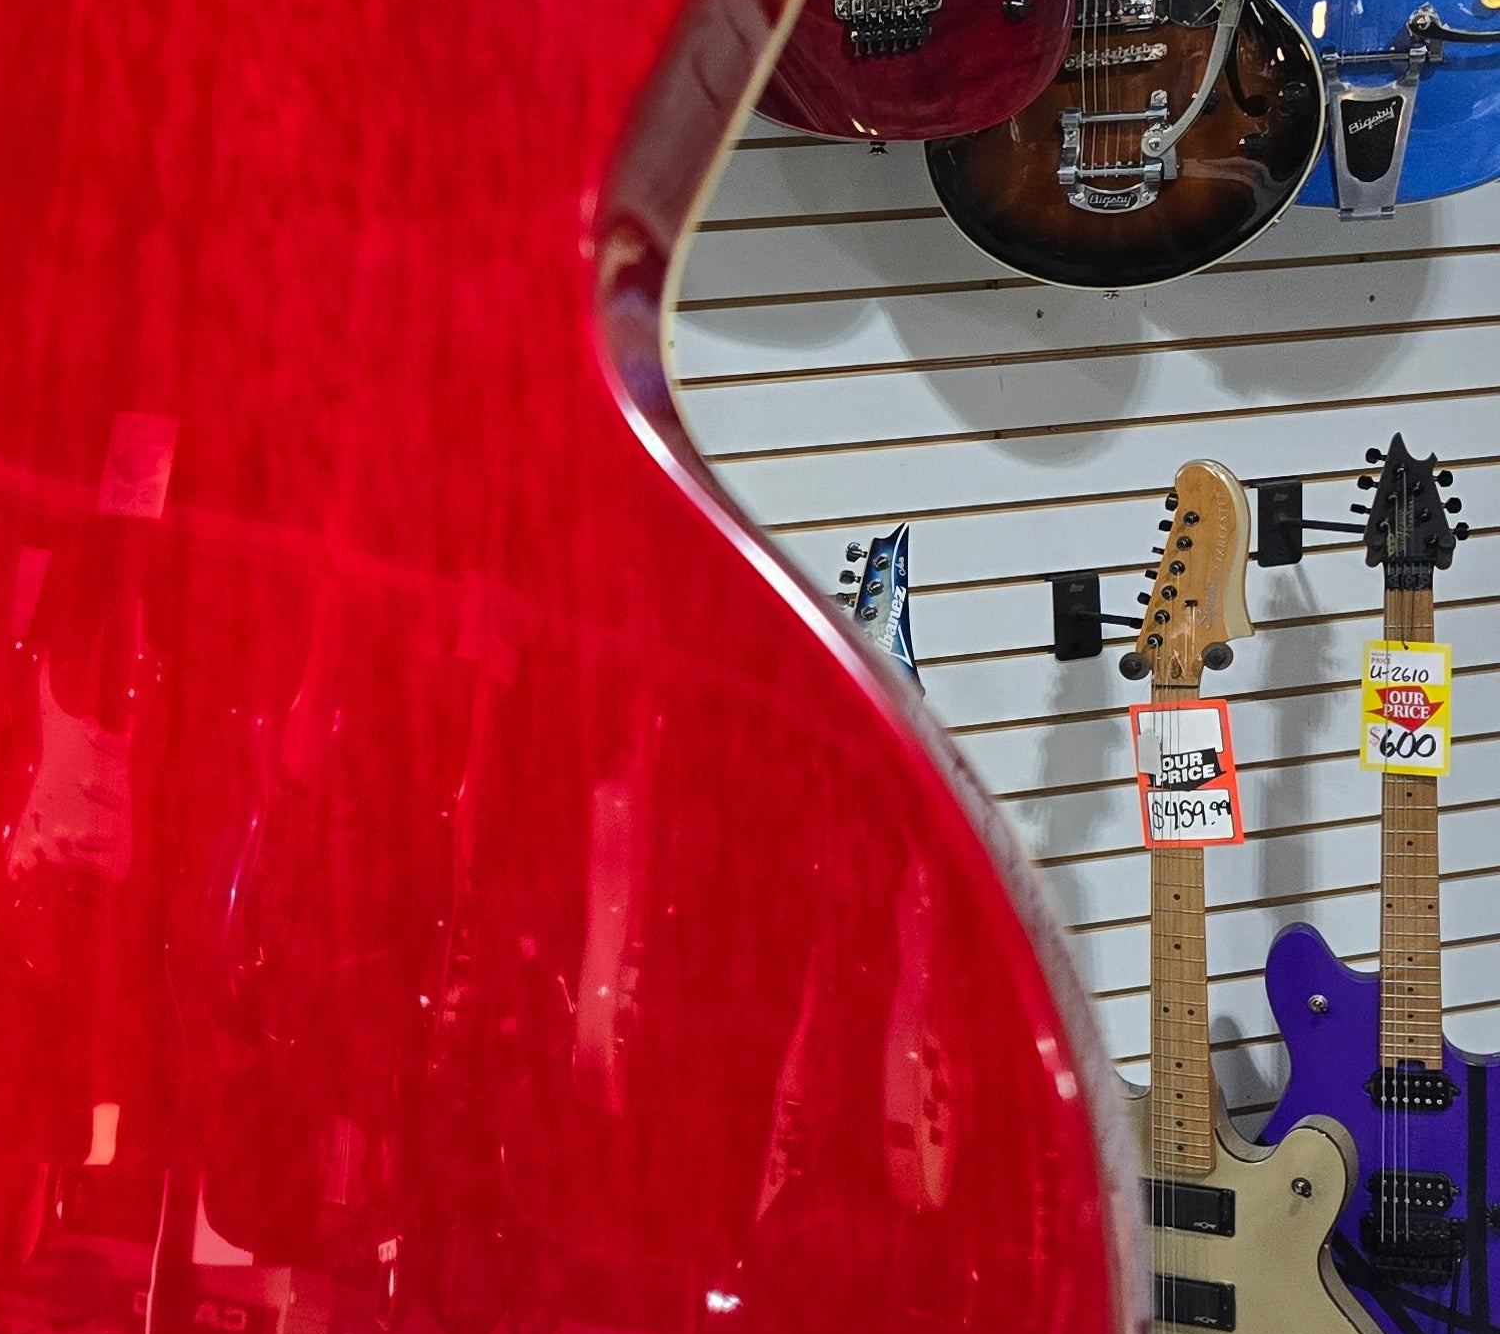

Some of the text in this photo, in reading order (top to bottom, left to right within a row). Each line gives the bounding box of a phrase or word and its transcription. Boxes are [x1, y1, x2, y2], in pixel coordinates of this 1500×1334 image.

[1347, 104, 1396, 135] Bigsby
[1089, 193, 1132, 208] Bigsby
[876, 585, 907, 657] Ibanez
[1389, 690, 1425, 706] OUR
[1383, 703, 1431, 719] PRICE
[1369, 727, 1437, 760] $600
[1162, 752, 1204, 772] OUR
[1155, 763, 1216, 787] PRICE
[1152, 799, 1232, 832] $459.99
